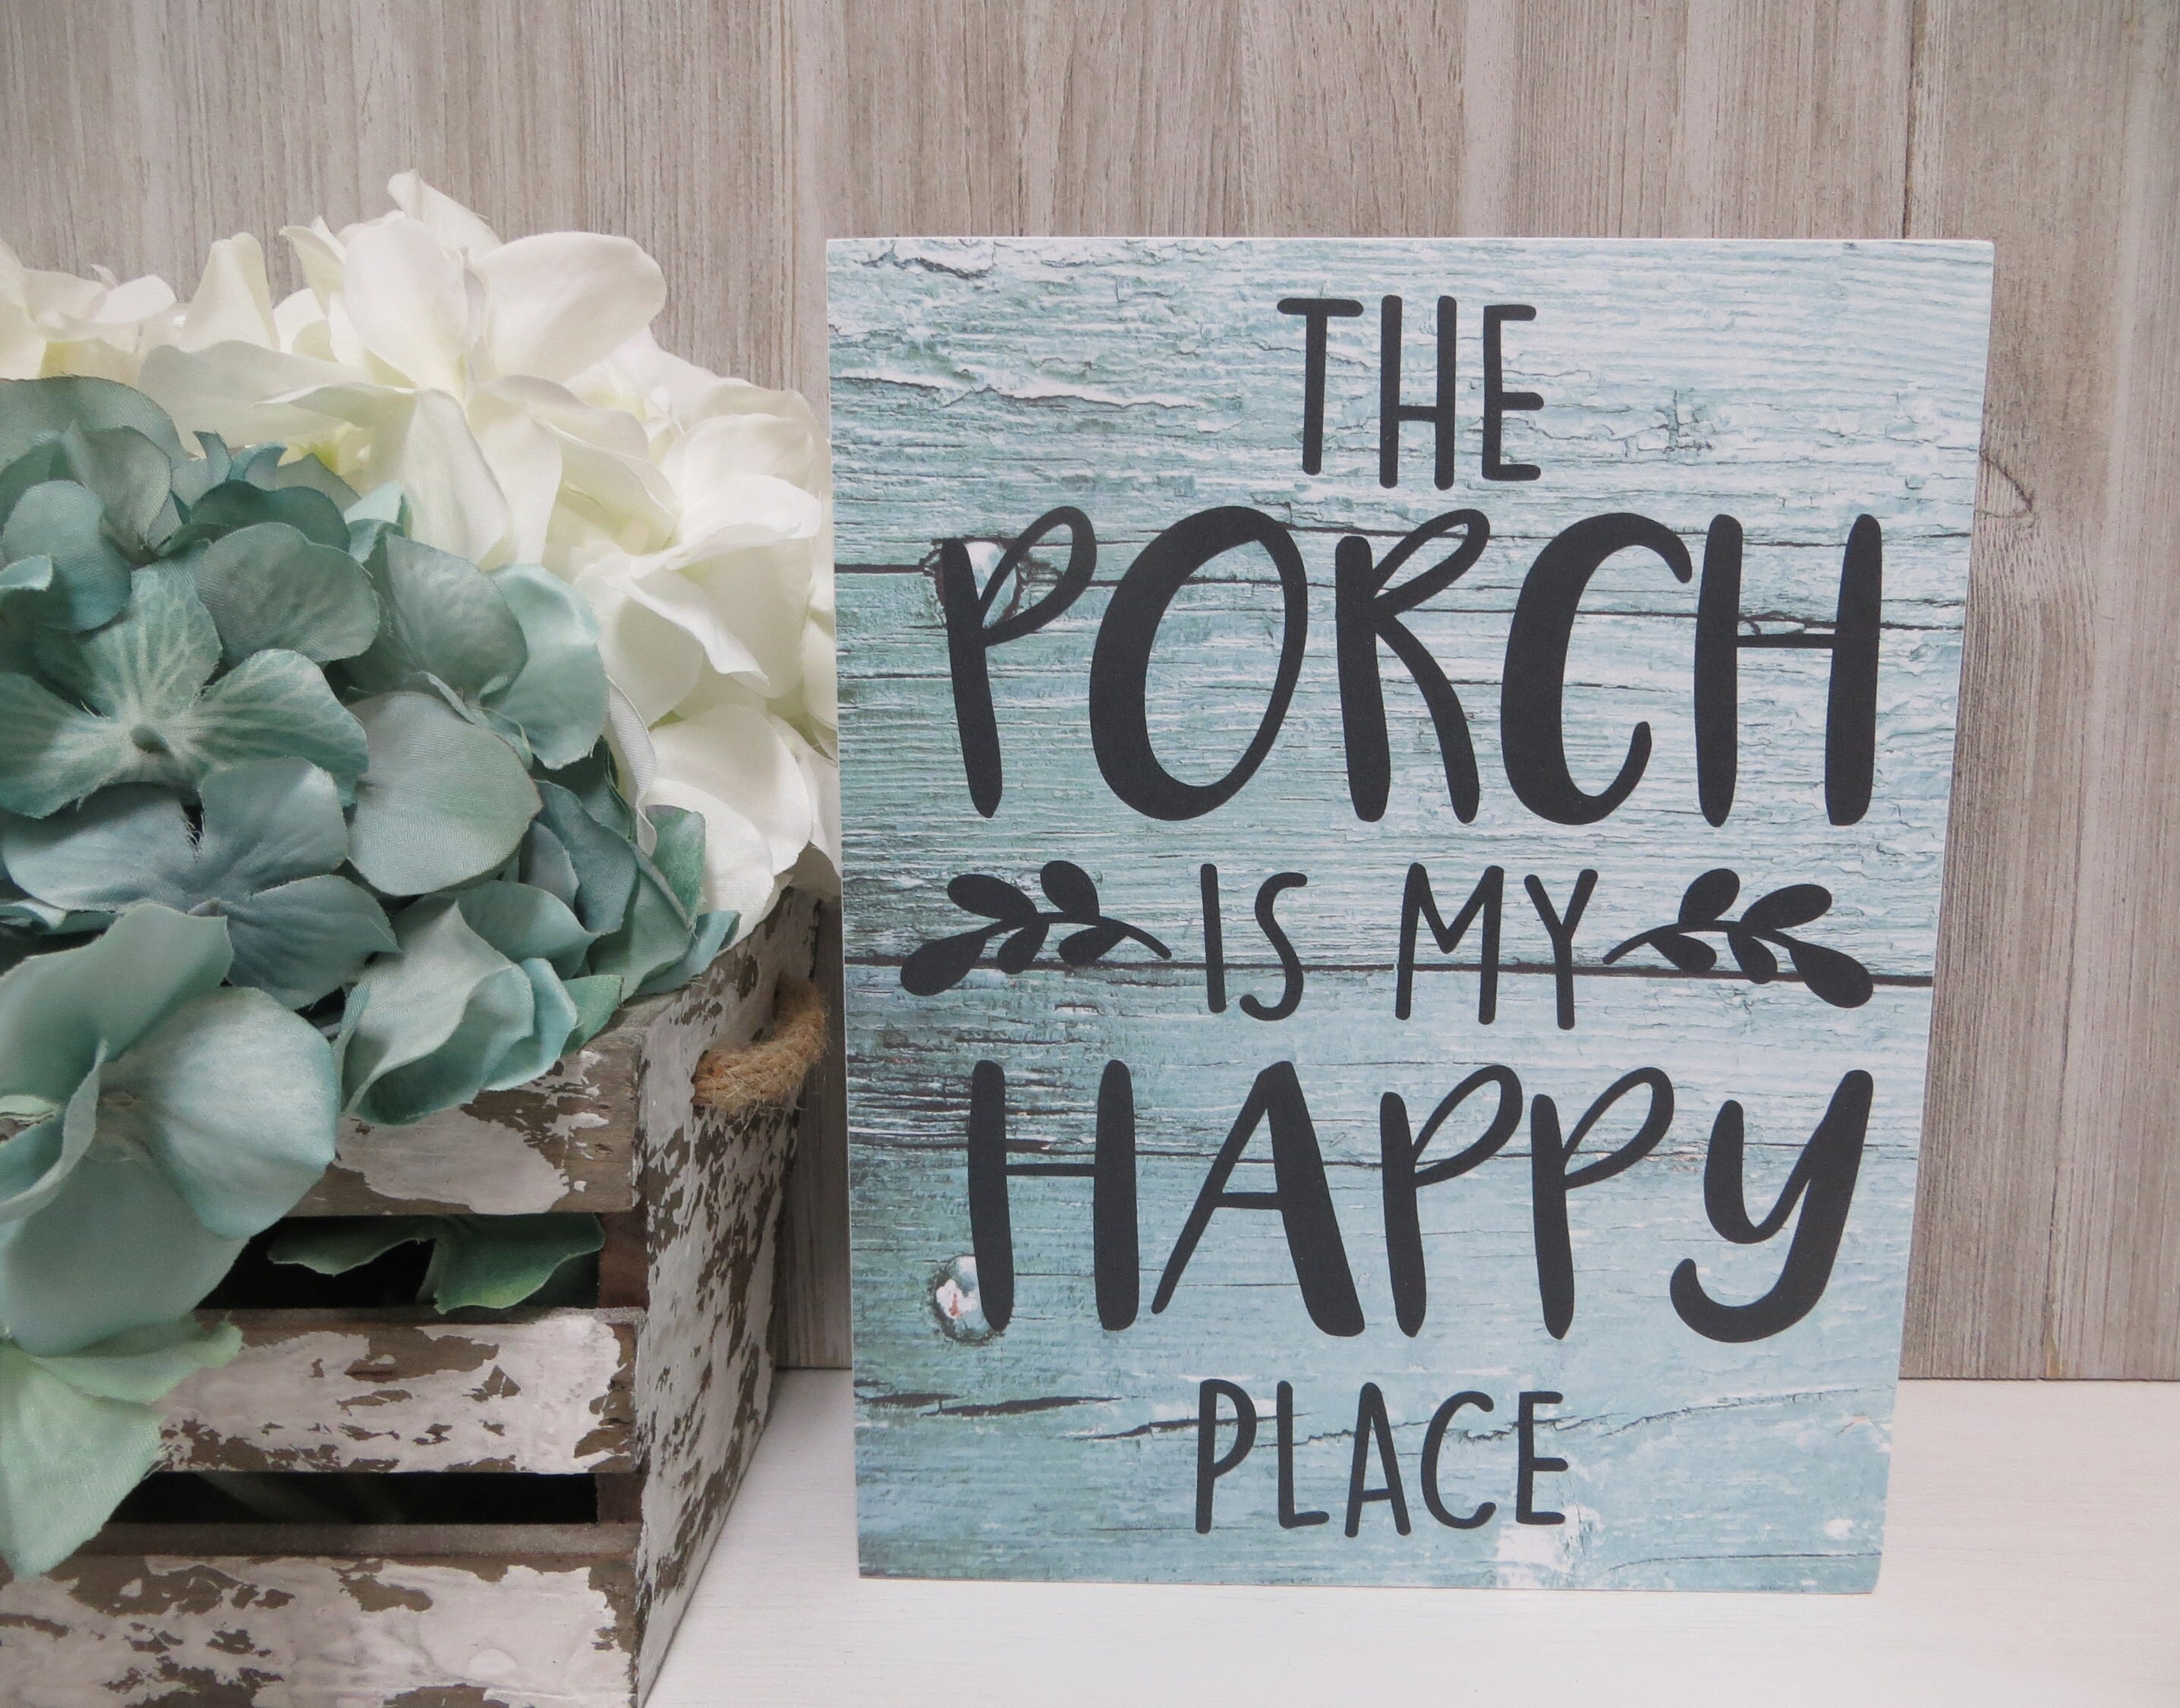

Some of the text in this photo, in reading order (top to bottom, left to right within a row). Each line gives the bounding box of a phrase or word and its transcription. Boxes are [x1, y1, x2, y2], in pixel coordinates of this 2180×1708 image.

[1278, 295, 1544, 490] THE
[943, 506, 1882, 827] PORCH
[1199, 863, 1599, 1030] IS MY
[970, 1060, 1873, 1343] HAPPY
[1196, 1380, 1568, 1537] PLACE
